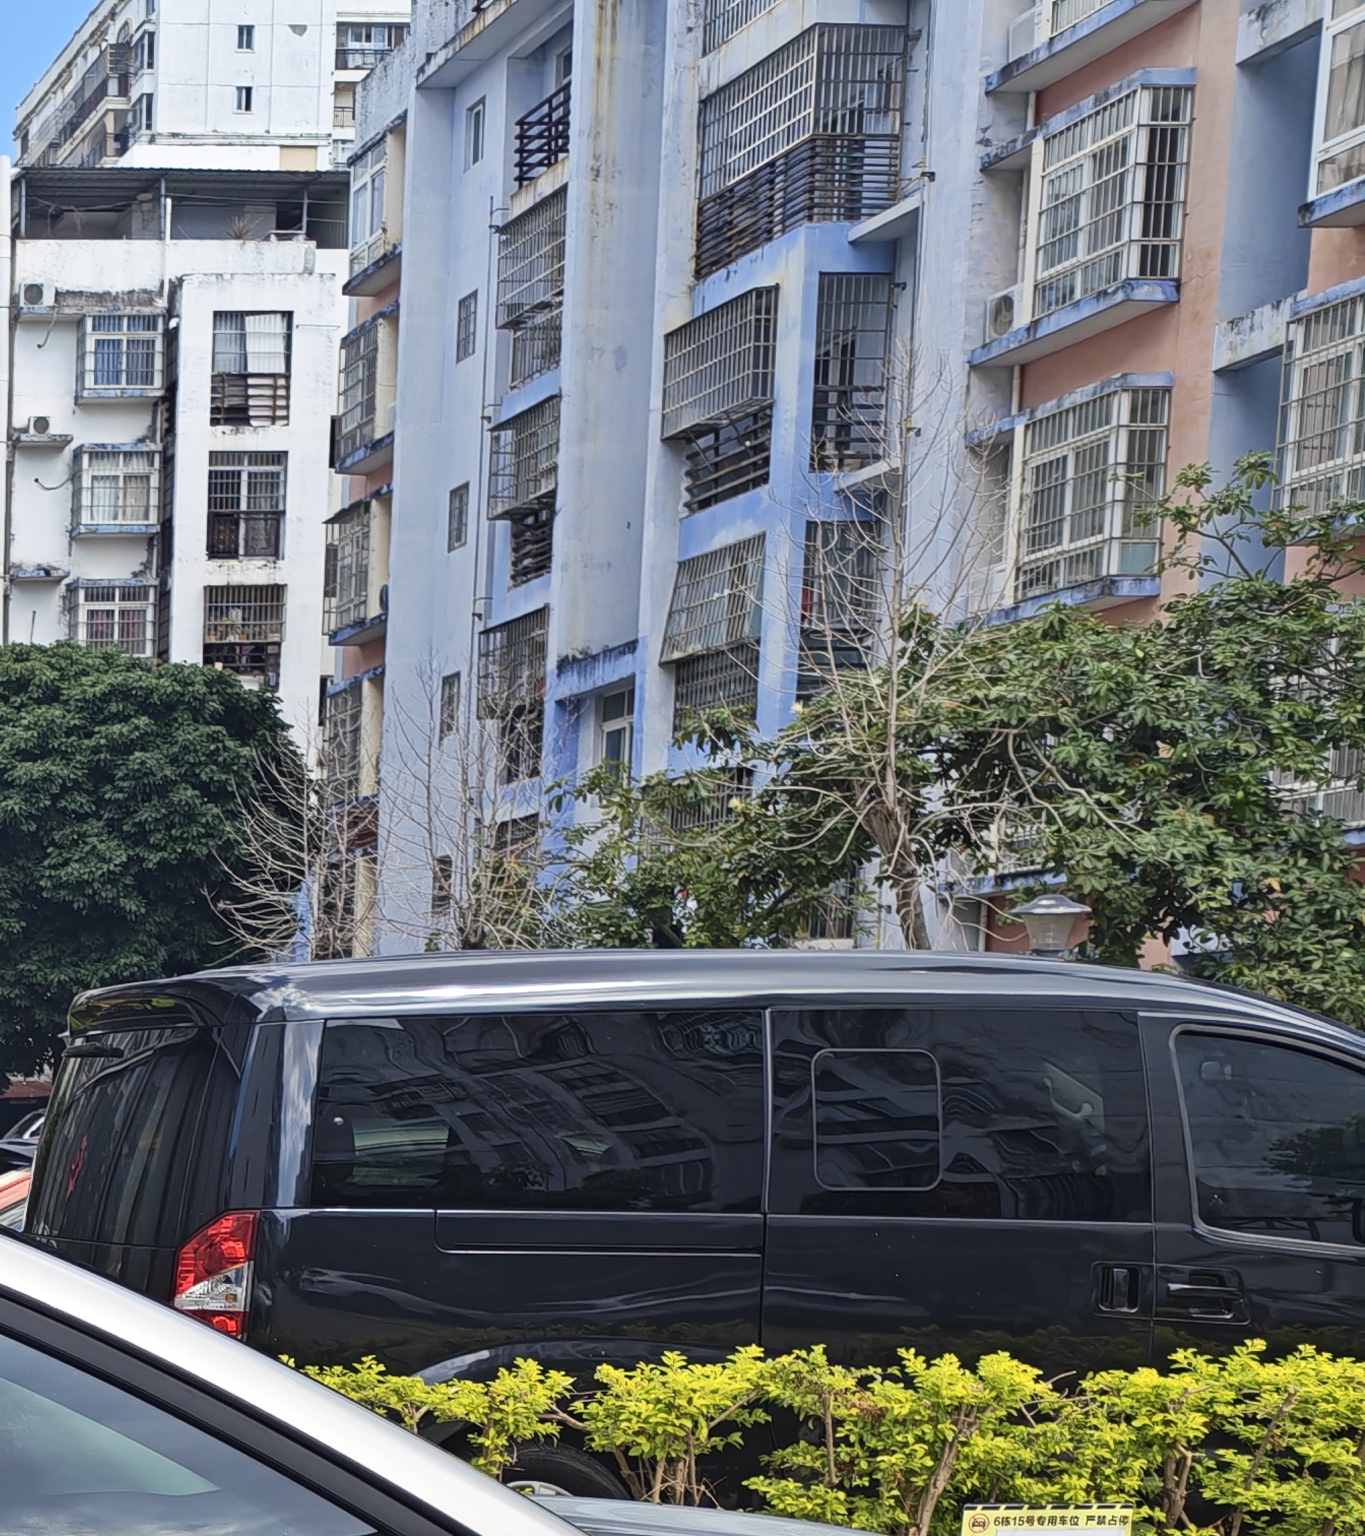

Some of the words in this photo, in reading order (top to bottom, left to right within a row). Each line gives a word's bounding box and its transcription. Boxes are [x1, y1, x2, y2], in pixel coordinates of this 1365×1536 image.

[993, 1515, 1080, 1527] 6栋15号专用车位
[1085, 1515, 1129, 1526] 严禁占停
